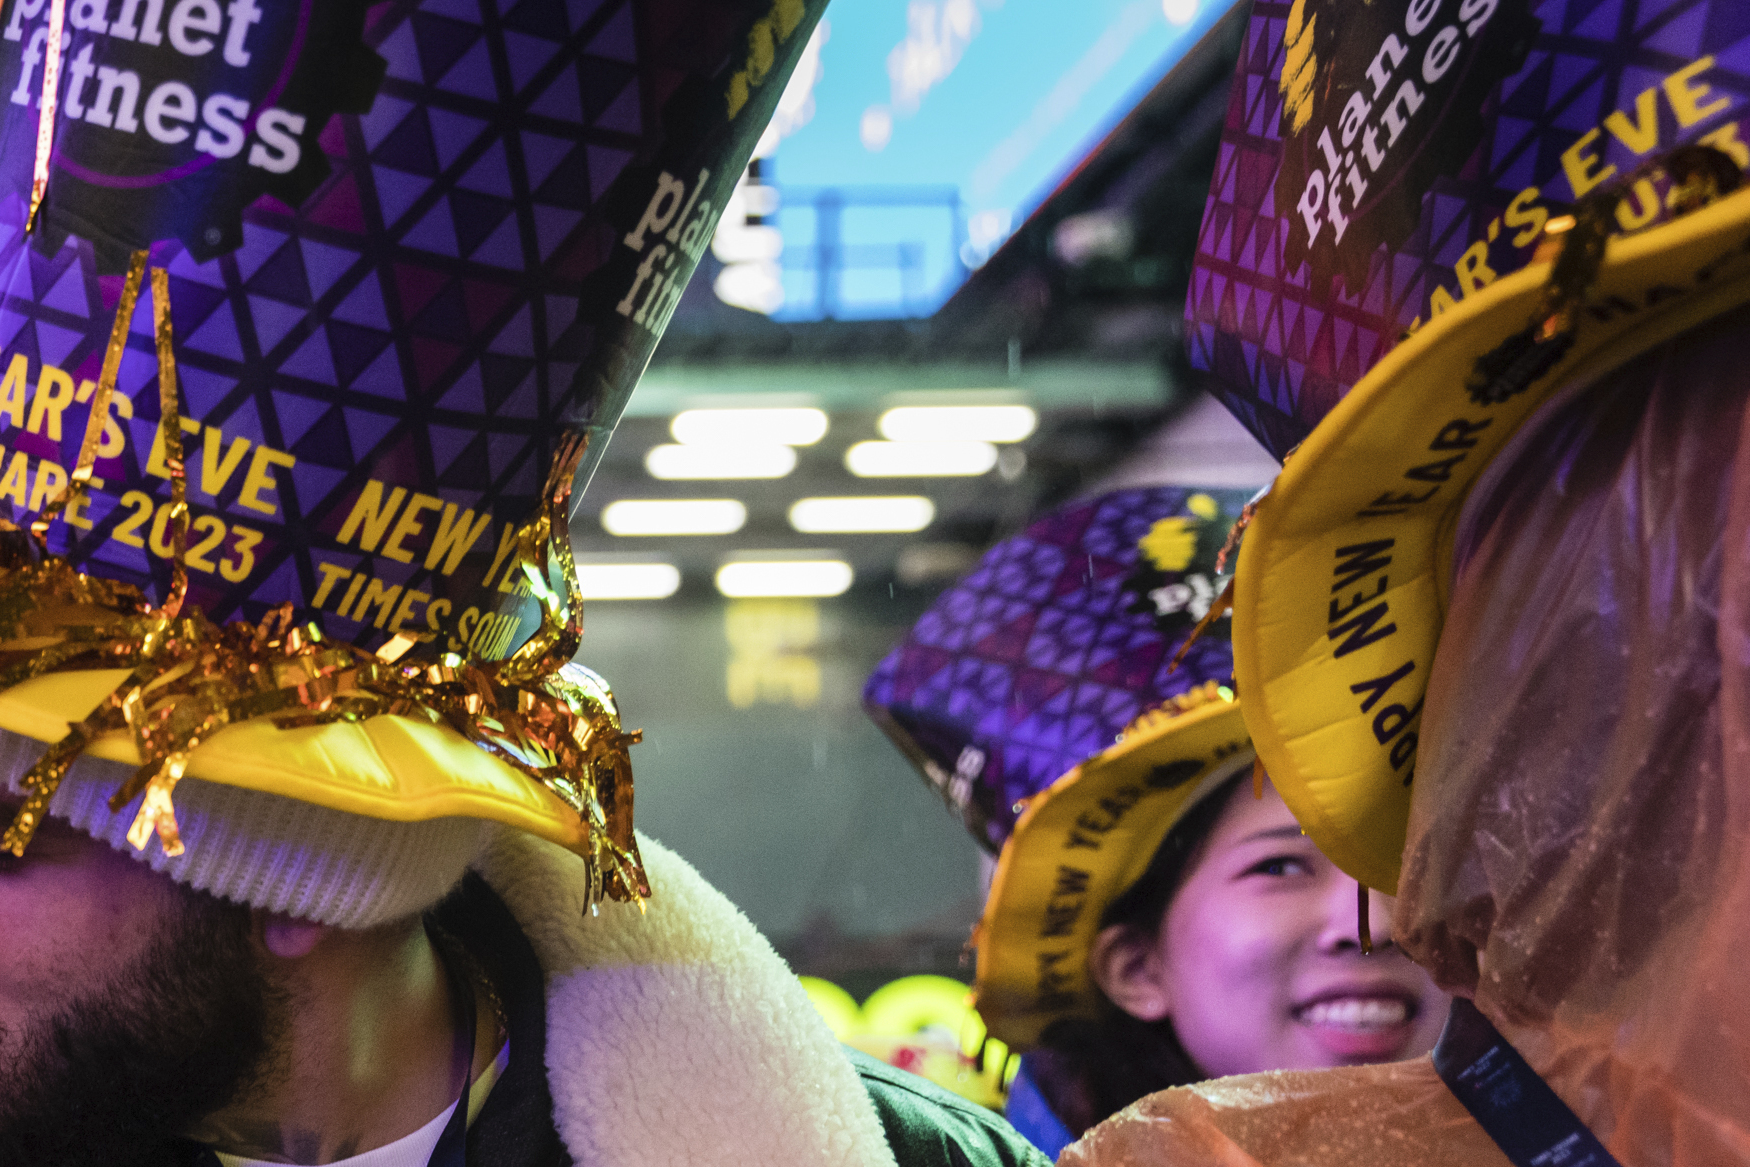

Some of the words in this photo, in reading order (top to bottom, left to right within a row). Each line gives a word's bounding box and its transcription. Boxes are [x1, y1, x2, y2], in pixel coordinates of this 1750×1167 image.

[1297, 0, 1442, 249] plane
[1328, 0, 1498, 246] fitnes
[1560, 54, 1732, 199] EVE
[336, 478, 492, 576] NEW
[1355, 417, 1493, 517] YEAR
[112, 490, 264, 583] 2023
[1328, 537, 1397, 660] NEW
